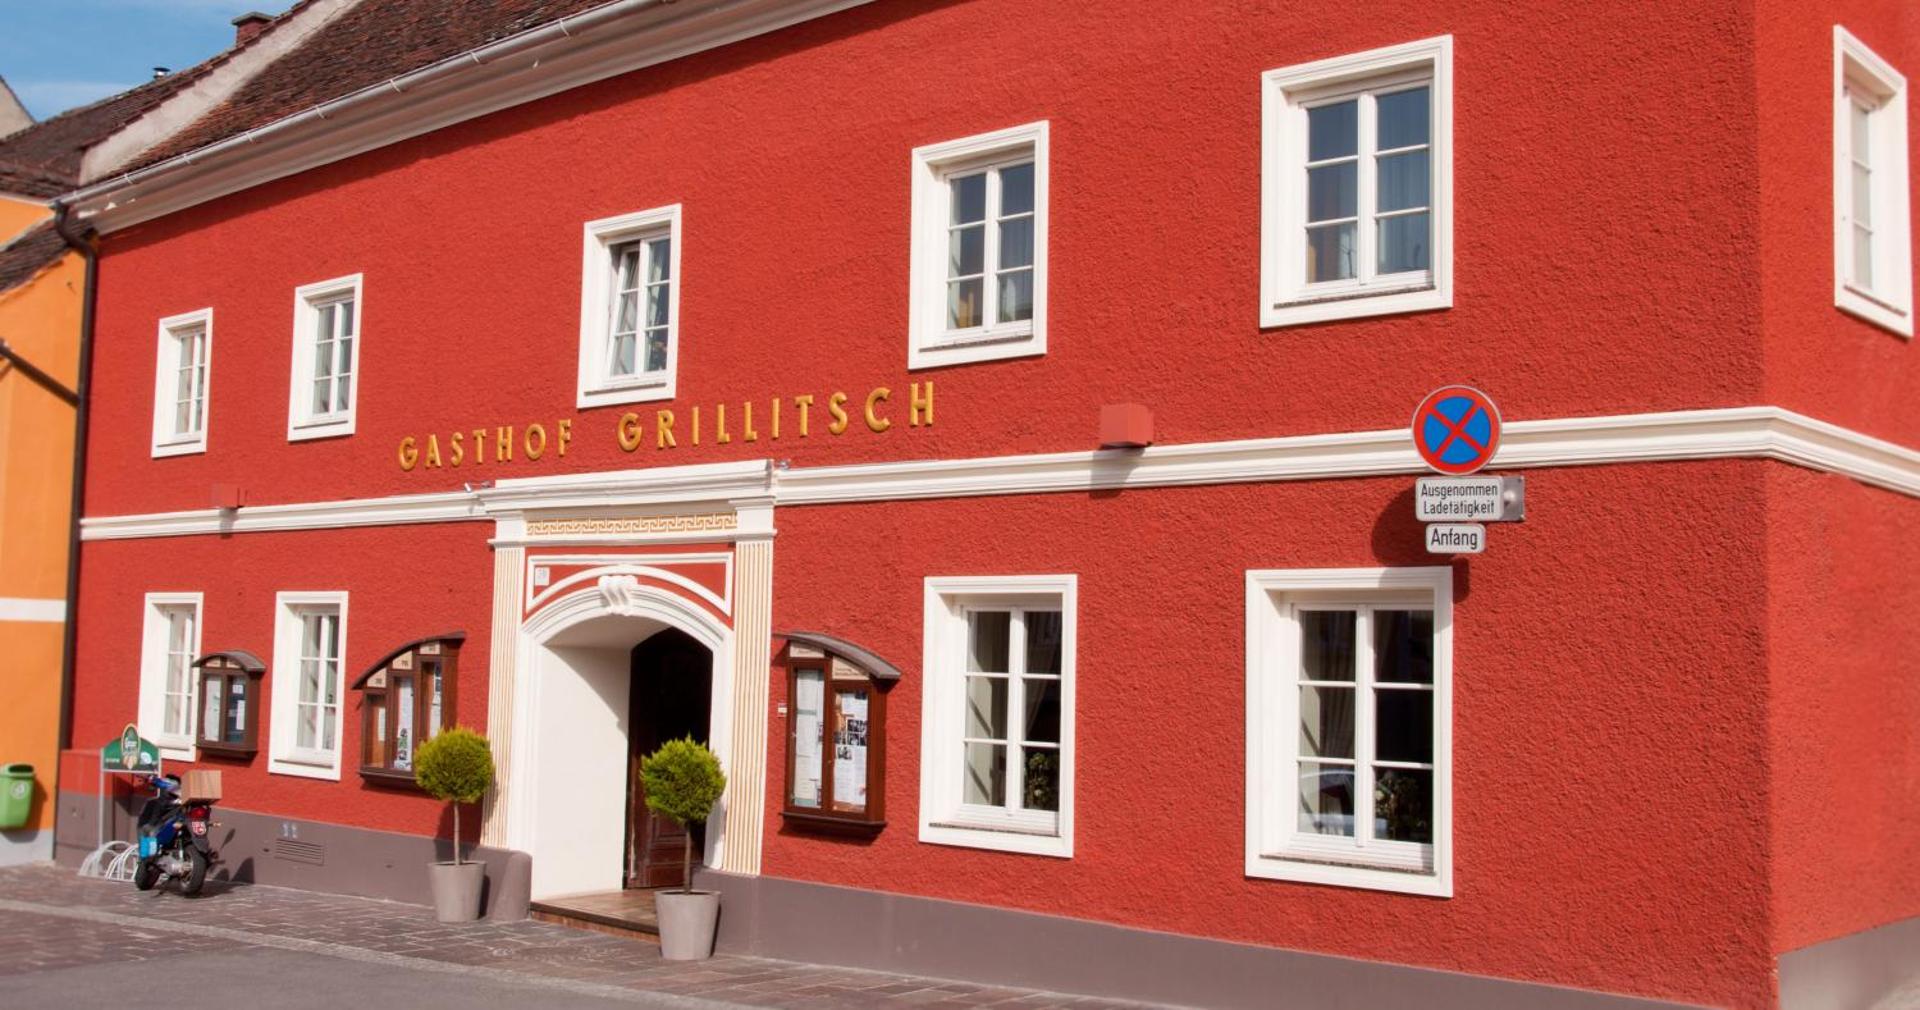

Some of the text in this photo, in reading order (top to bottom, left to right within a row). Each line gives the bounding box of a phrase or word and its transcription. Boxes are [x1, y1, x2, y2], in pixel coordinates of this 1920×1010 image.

[398, 380, 935, 472] GASTHOF GRILLITSCH
[1421, 483, 1498, 499] Ausgenommen
[1423, 500, 1494, 517] Ladetätigkeit
[1430, 528, 1478, 549] Anfang
